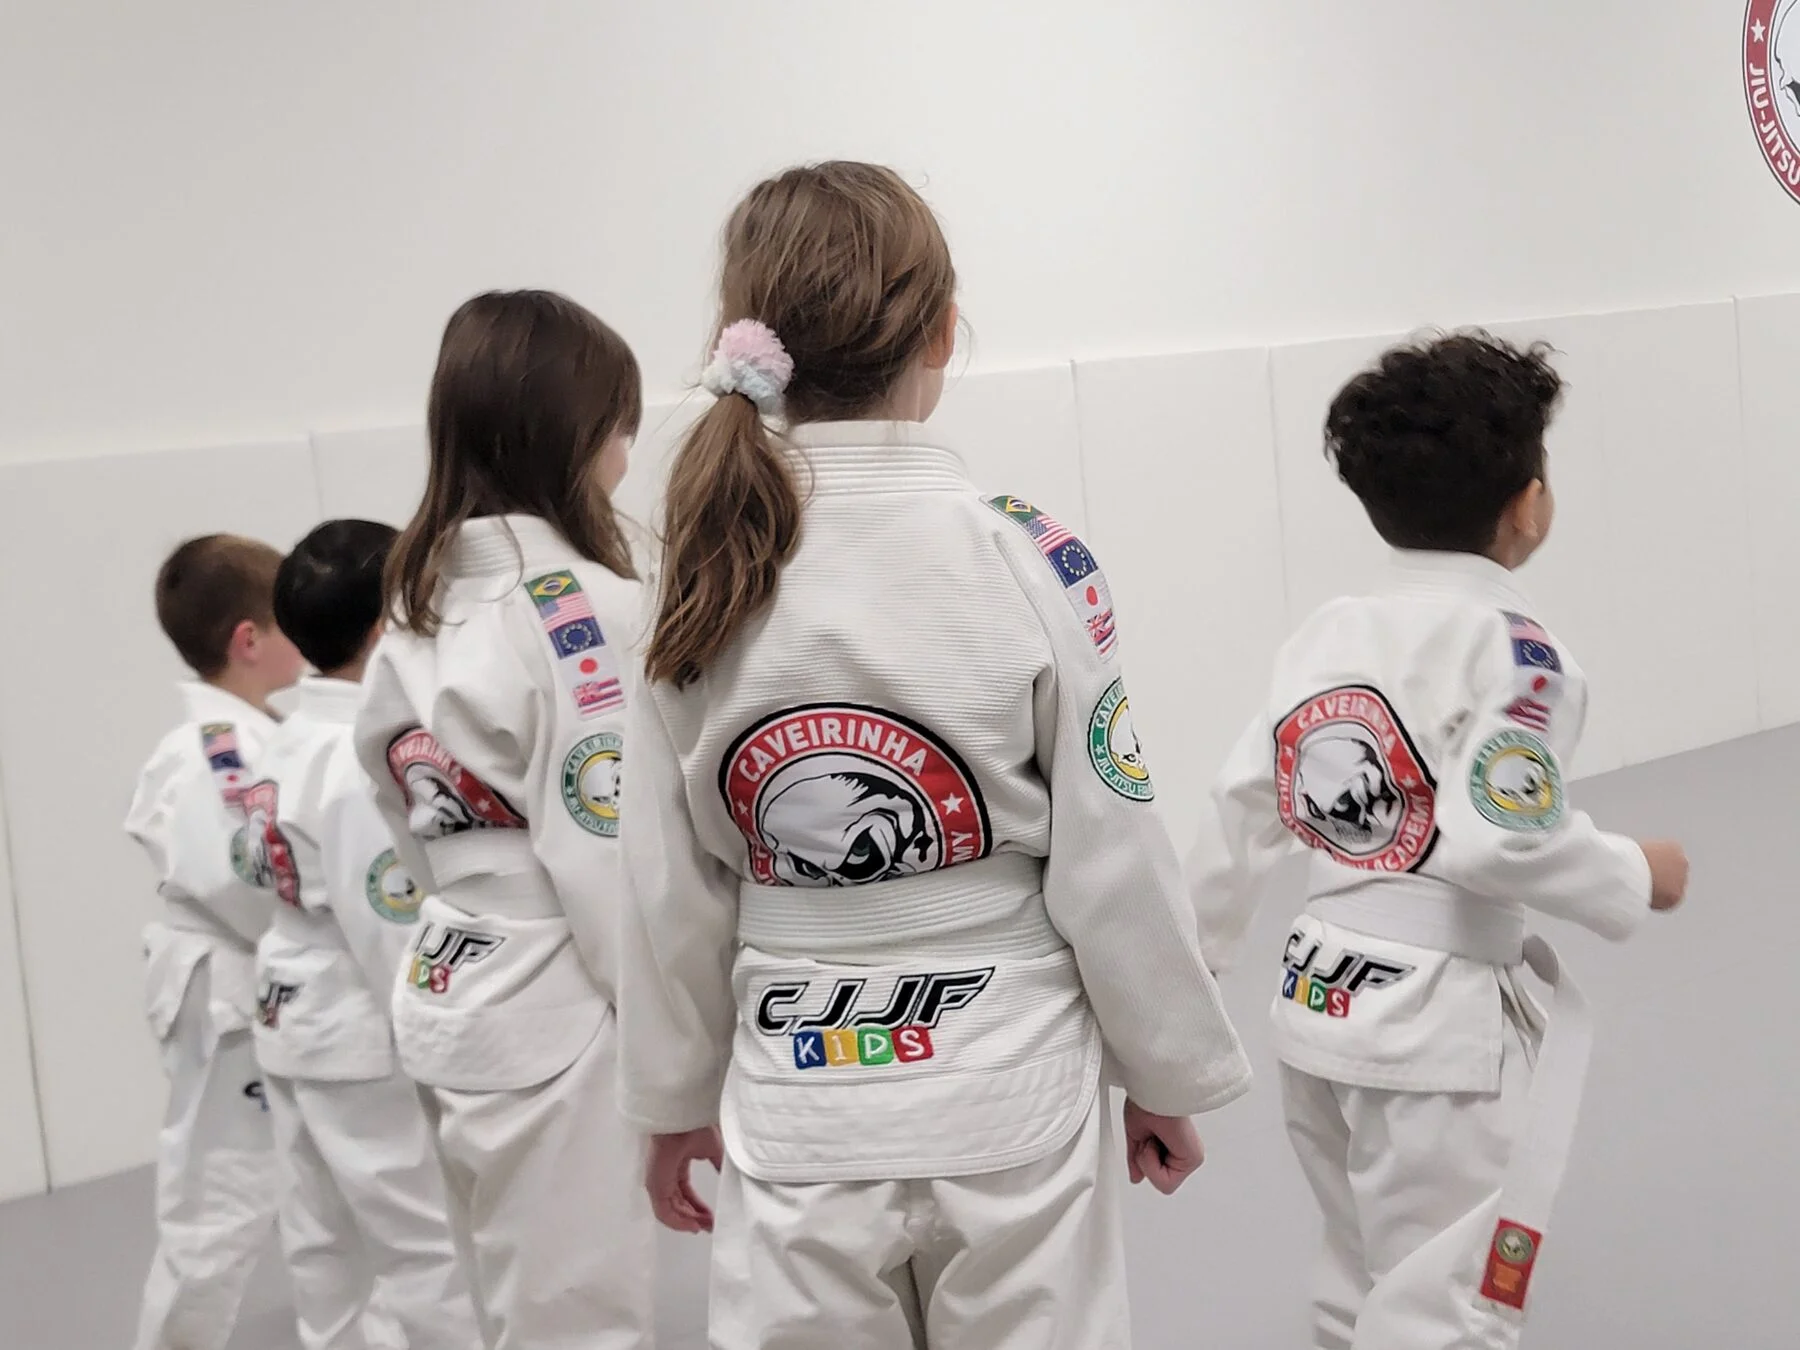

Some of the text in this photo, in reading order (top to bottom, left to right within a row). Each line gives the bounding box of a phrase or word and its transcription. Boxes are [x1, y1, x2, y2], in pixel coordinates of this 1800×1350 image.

[1750, 62, 1800, 186] JIU-JITSU
[738, 717, 928, 783] CAVEIRINHA
[1297, 695, 1396, 756] CAVEIRA
[1282, 929, 1417, 998] CJJF
[1283, 971, 1347, 1018] KIDS
[756, 966, 996, 1036] CJJF
[795, 1029, 929, 1066] KIDS
